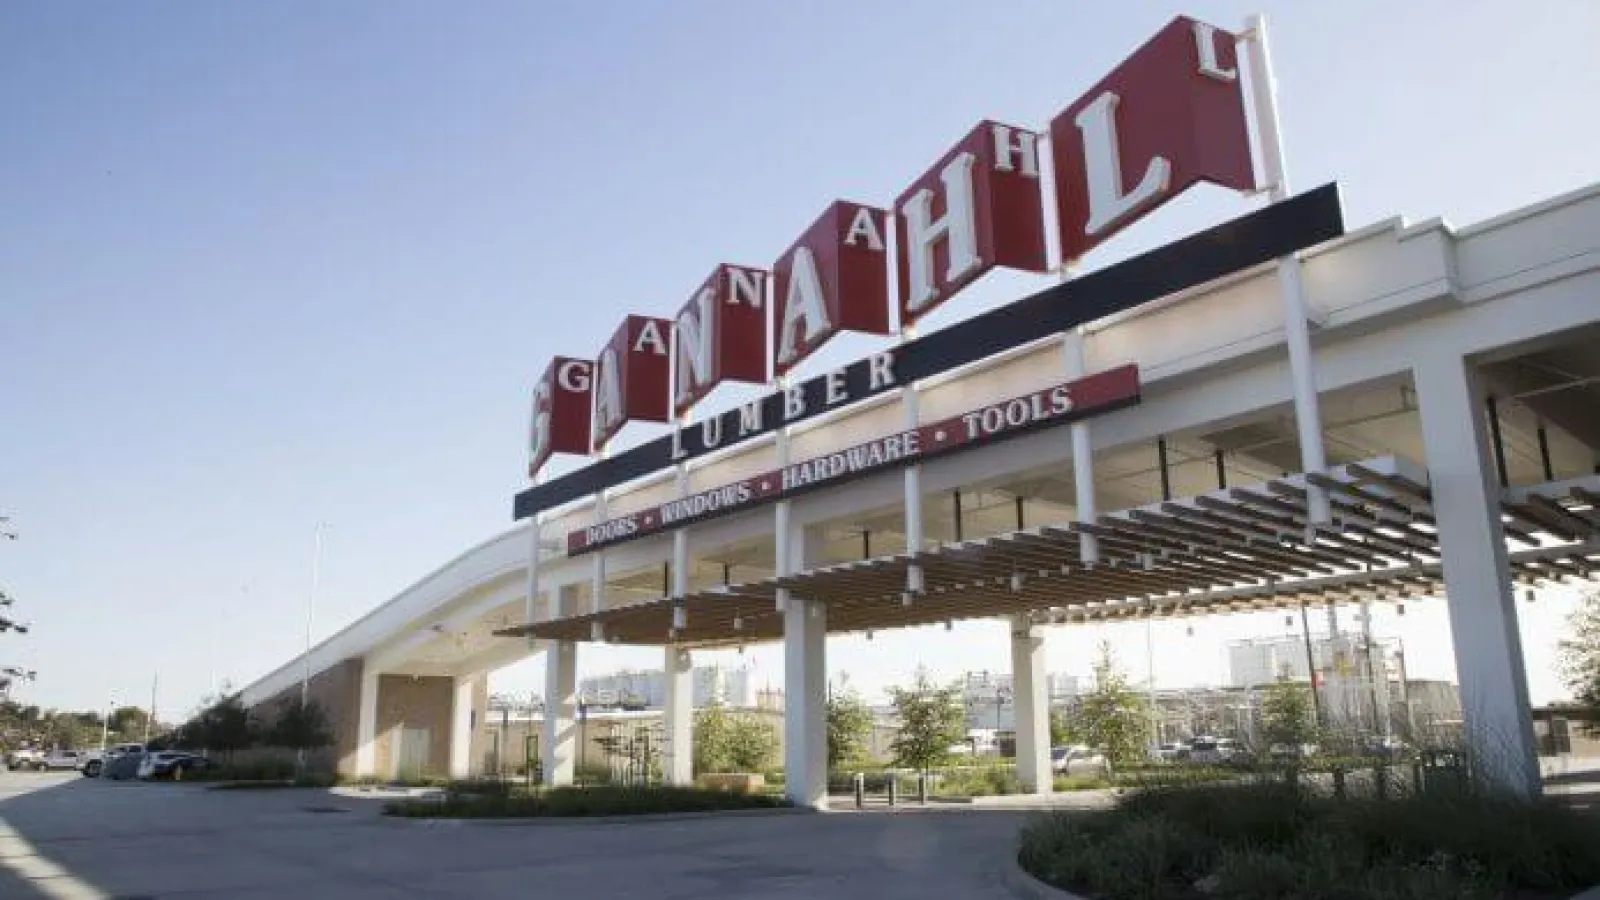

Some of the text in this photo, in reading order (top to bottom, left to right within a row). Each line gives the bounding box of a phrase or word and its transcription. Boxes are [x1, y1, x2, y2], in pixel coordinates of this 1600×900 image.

[661, 480, 750, 524] WINDOWS
[782, 431, 922, 490] HARDWARE
[963, 386, 1075, 440] TOOLS
[671, 350, 897, 460] LUMBER
